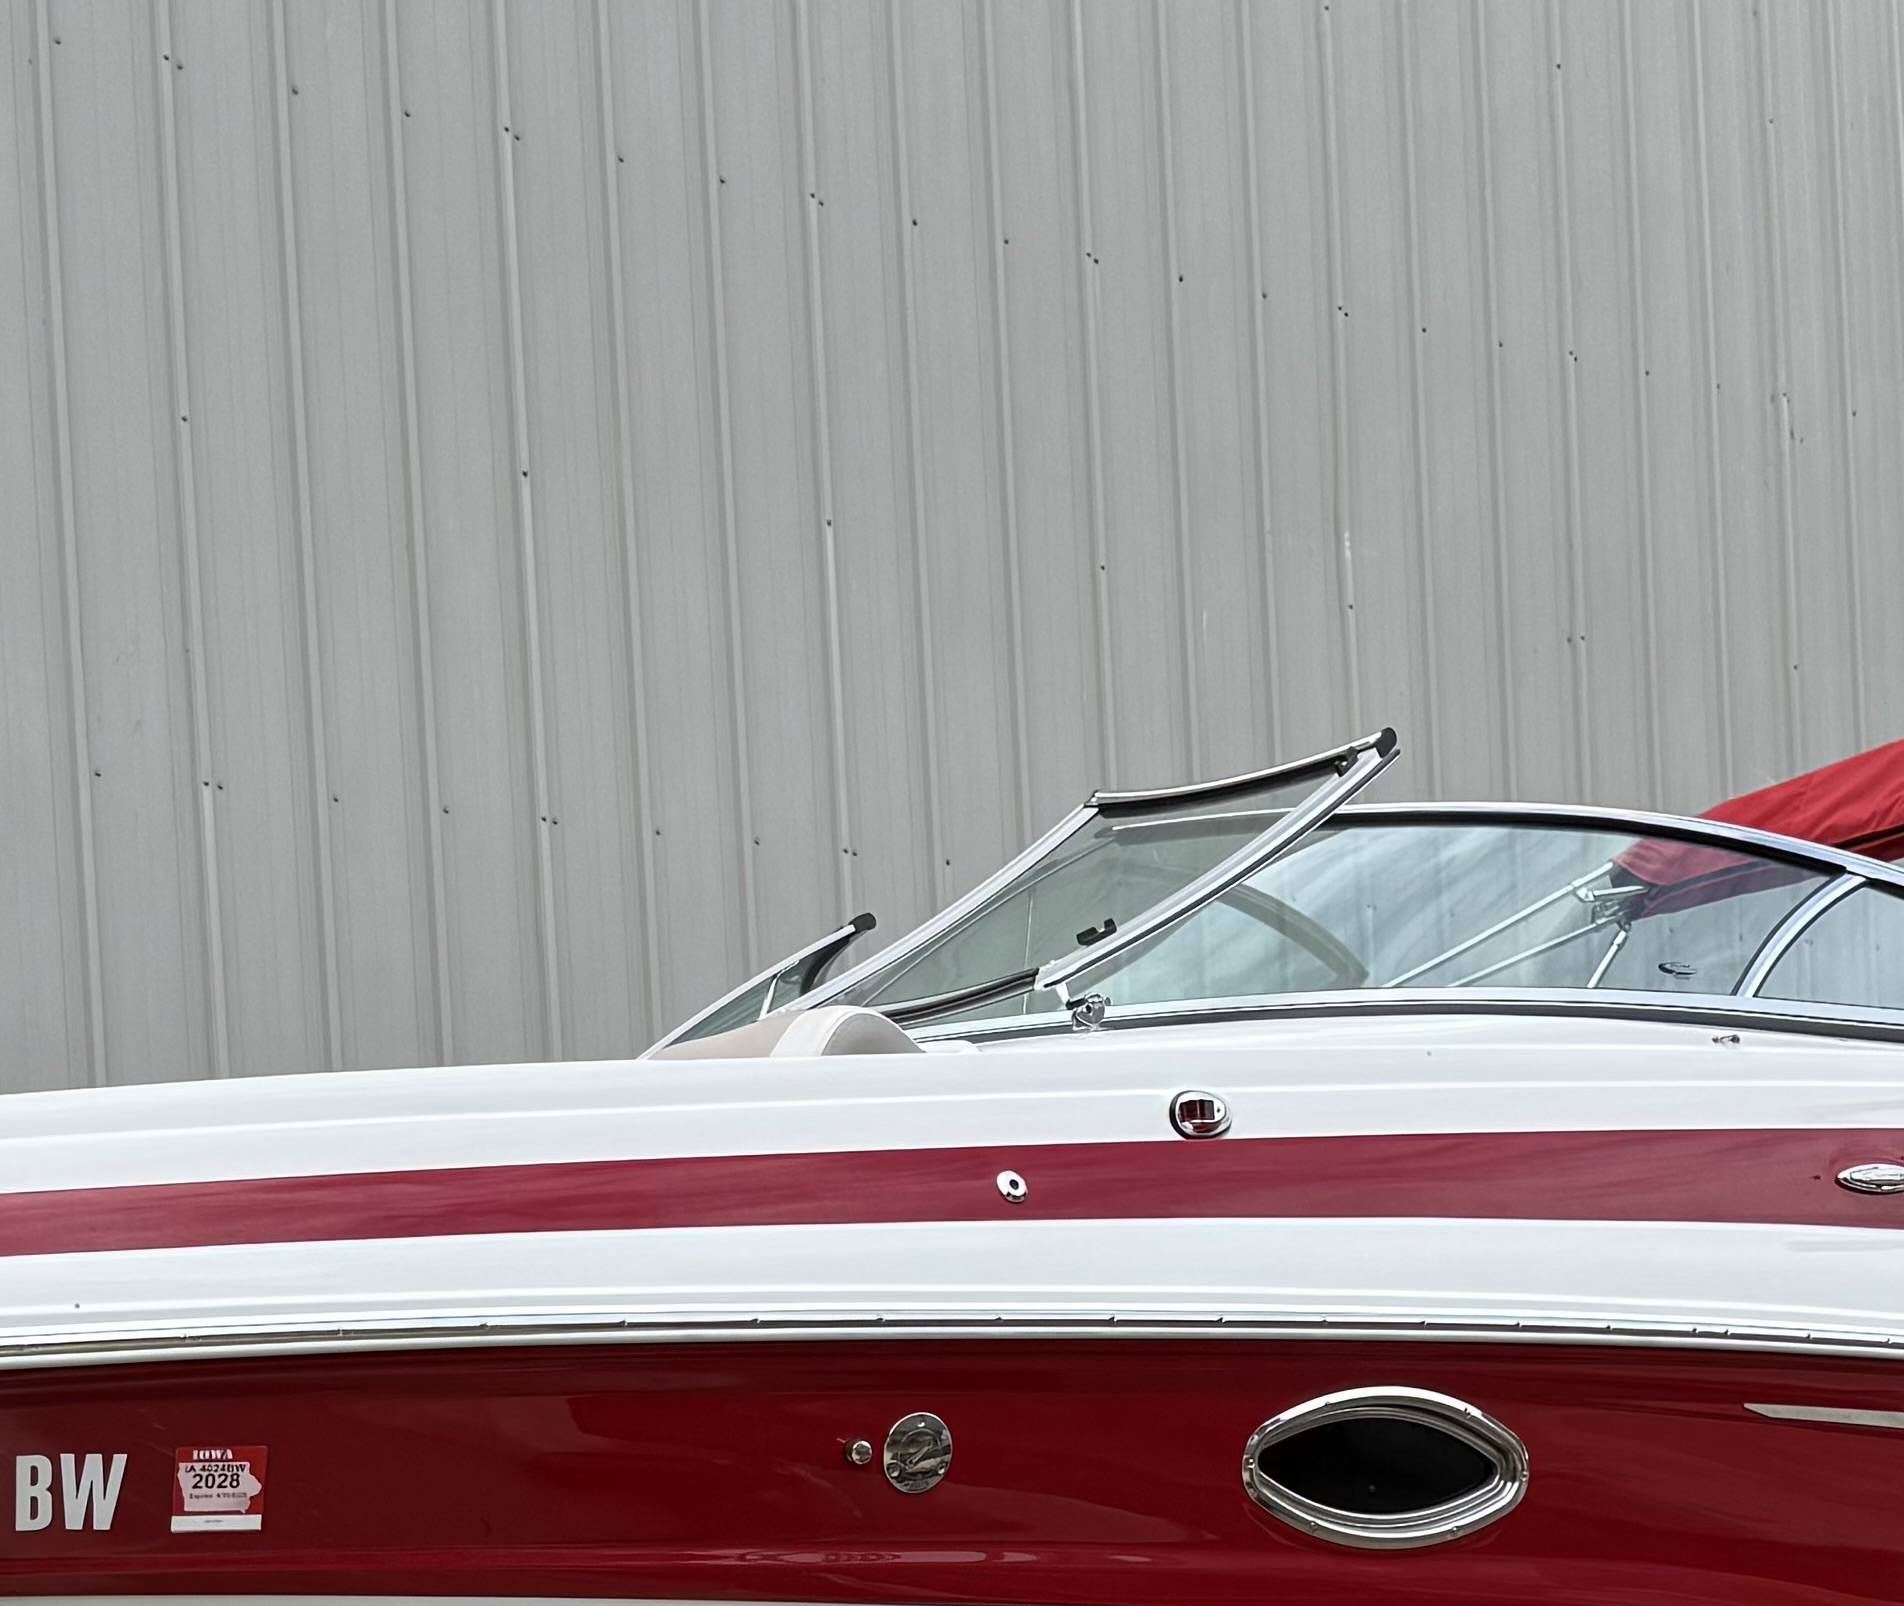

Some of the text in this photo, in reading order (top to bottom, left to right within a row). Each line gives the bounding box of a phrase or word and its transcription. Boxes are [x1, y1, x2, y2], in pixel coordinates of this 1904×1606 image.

[192, 1449, 233, 1460] IOWA
[192, 1472, 241, 1489] 2028
[15, 1453, 128, 1532] BW
